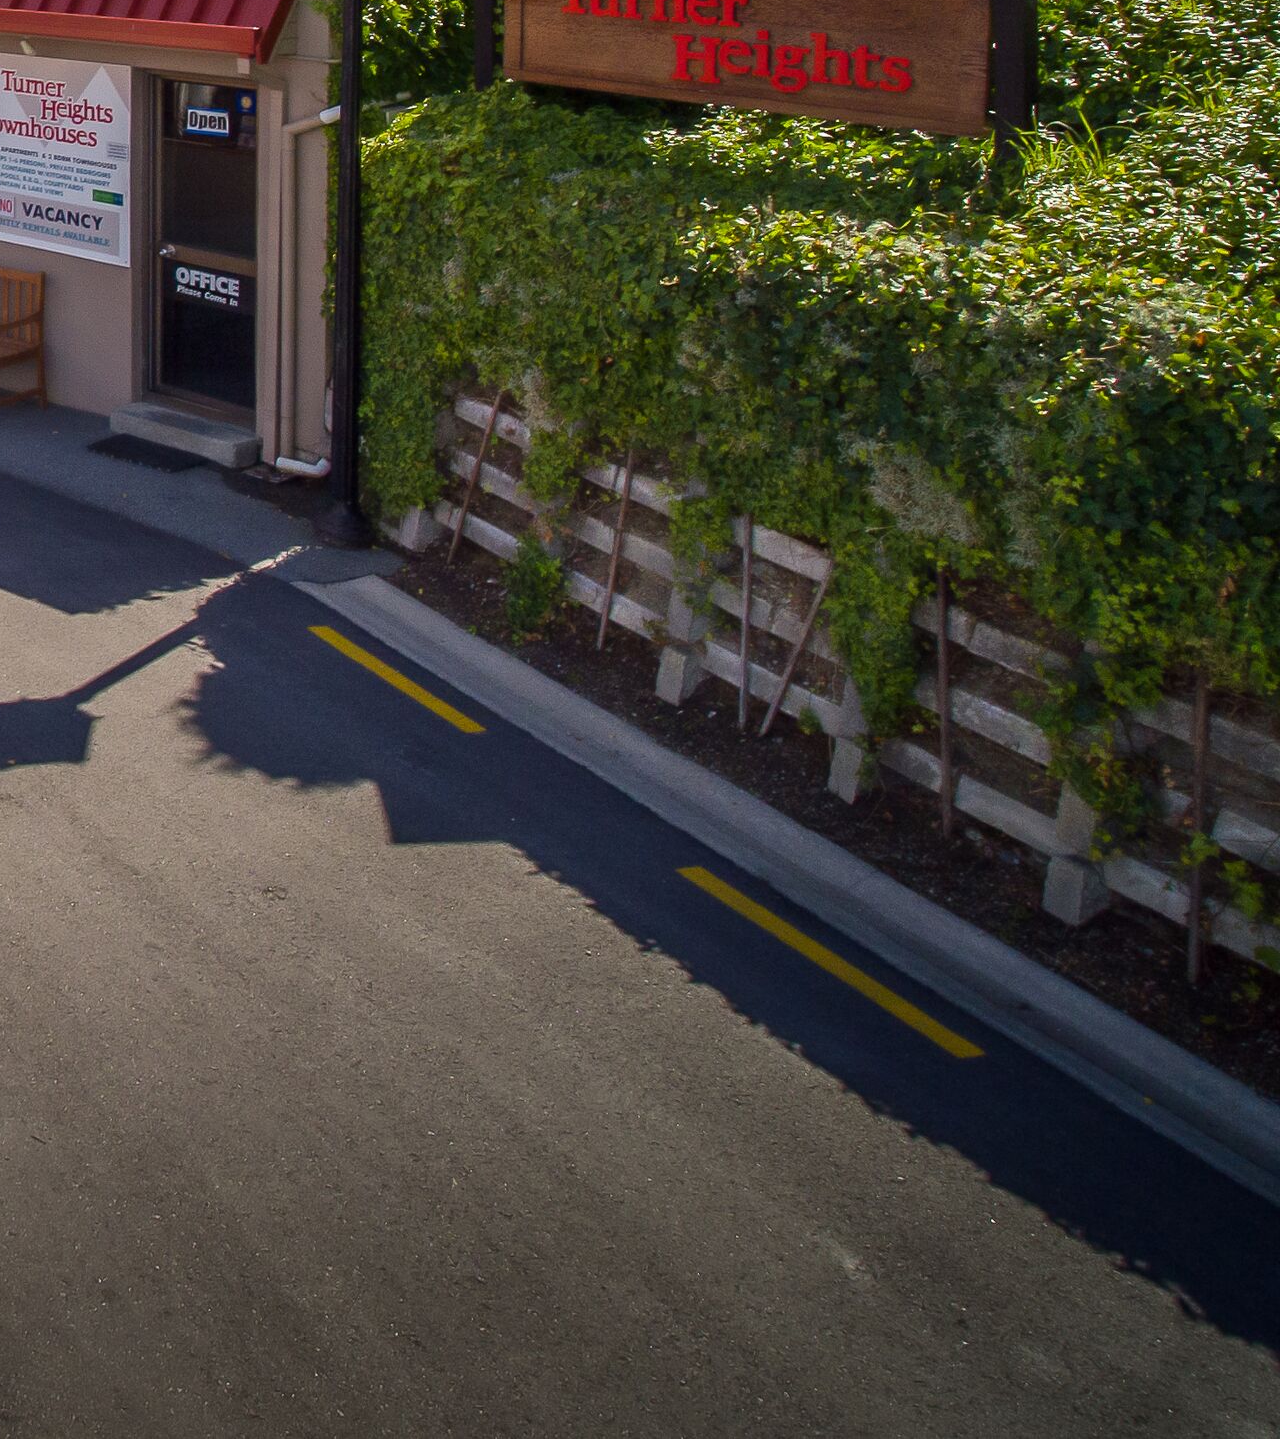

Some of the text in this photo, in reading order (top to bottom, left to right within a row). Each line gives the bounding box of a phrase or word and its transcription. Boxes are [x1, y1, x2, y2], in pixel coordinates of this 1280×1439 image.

[671, 29, 913, 93] Heights
[0, 69, 66, 98] Turner
[40, 97, 113, 125] Heights
[189, 111, 228, 131] Open
[1, 146, 39, 158] APARTMENTS
[73, 157, 118, 170] TOWNHOUSES
[1, 163, 36, 175] CONTAINED
[80, 177, 111, 187] LAUNDRY
[49, 163, 74, 173] PRIVATE
[76, 167, 111, 179] BEDROOMS
[44, 179, 84, 192] COURTYARDS
[44, 188, 64, 197] VIEWS
[21, 201, 104, 231] VACANCY
[22, 222, 60, 237] RENTALS
[63, 230, 112, 248] AVAILABLE
[175, 266, 240, 297] OFFICE
[176, 284, 239, 307] Please Come In
